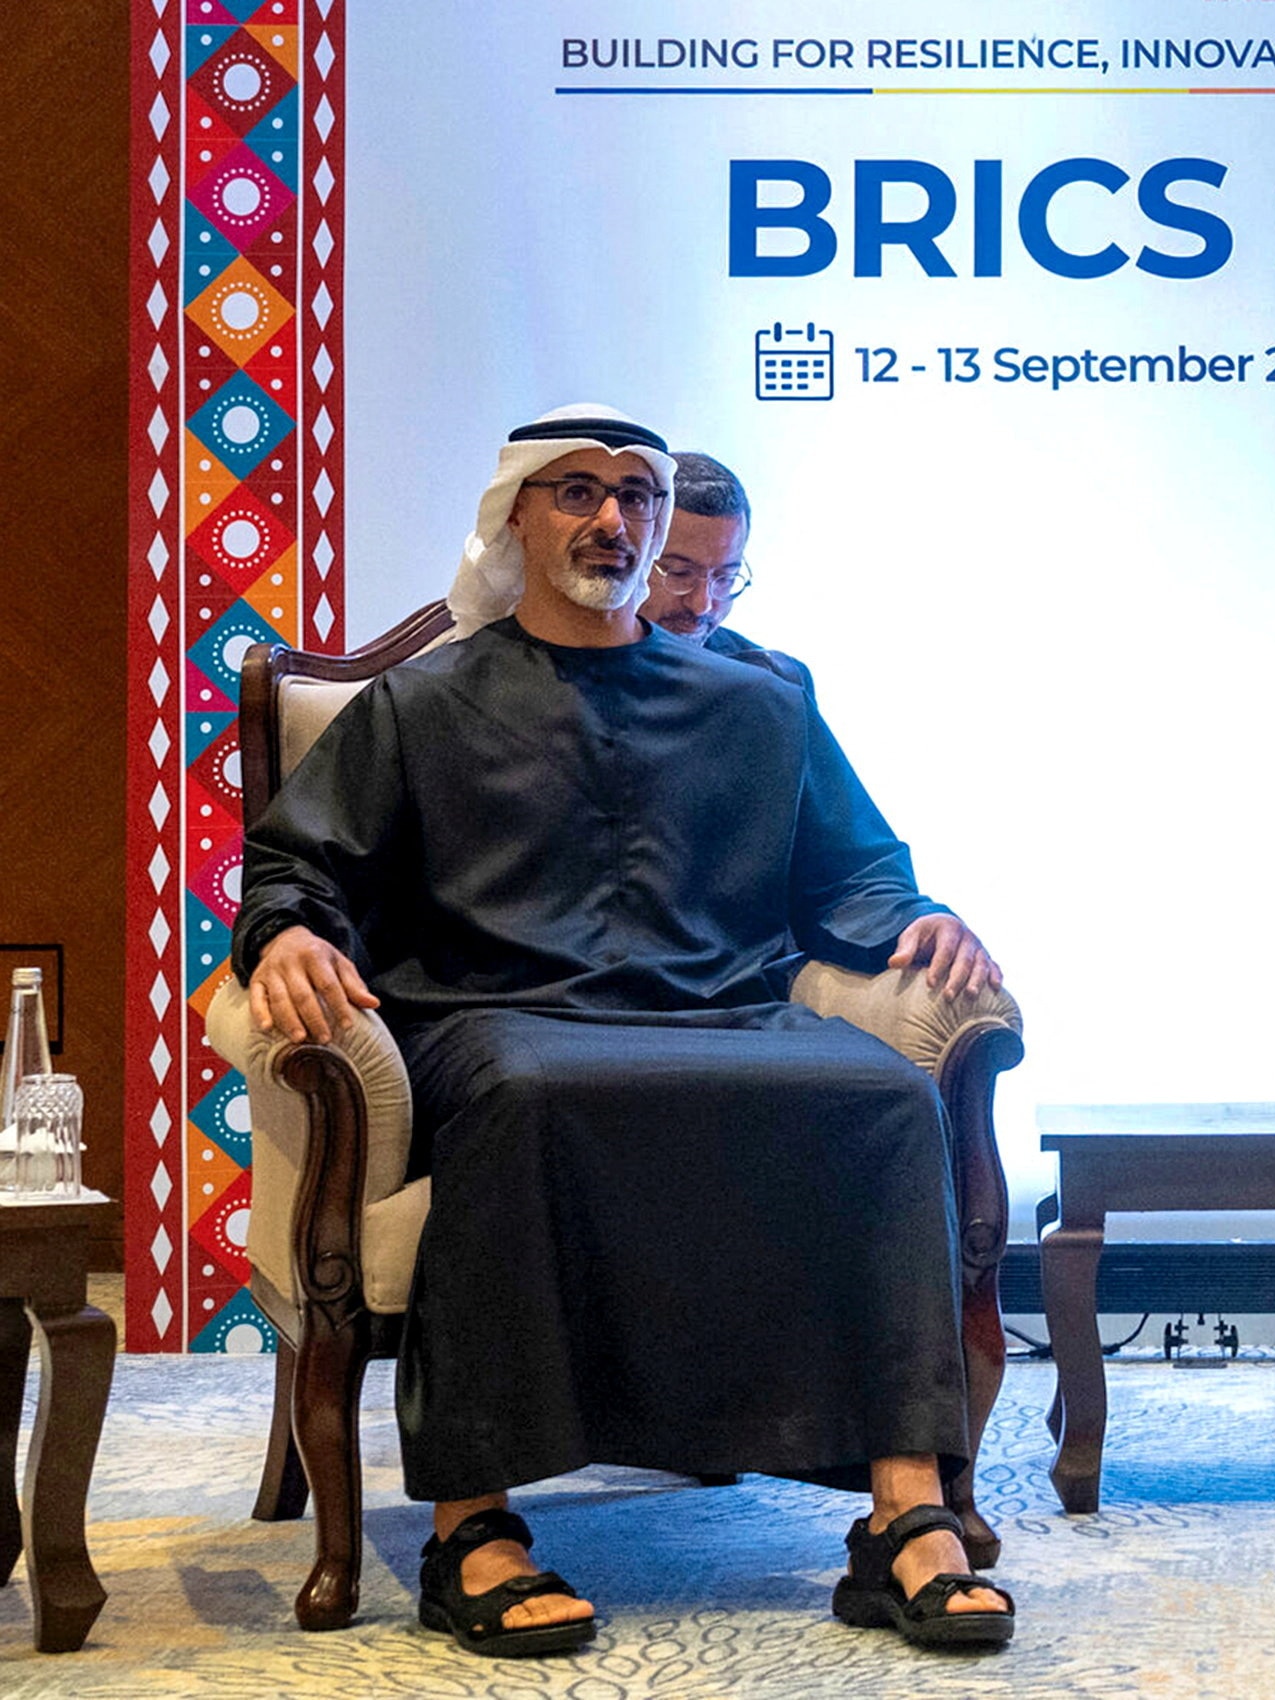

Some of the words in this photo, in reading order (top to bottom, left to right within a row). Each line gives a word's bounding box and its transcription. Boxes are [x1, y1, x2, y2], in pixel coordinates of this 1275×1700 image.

[562, 38, 758, 68] BUILDING
[773, 39, 854, 68] FOR
[868, 39, 1109, 75] RESILIENCE,
[728, 157, 1233, 280] BRICS
[855, 347, 899, 382] 12
[937, 348, 981, 383] 13
[994, 345, 1254, 391] September
